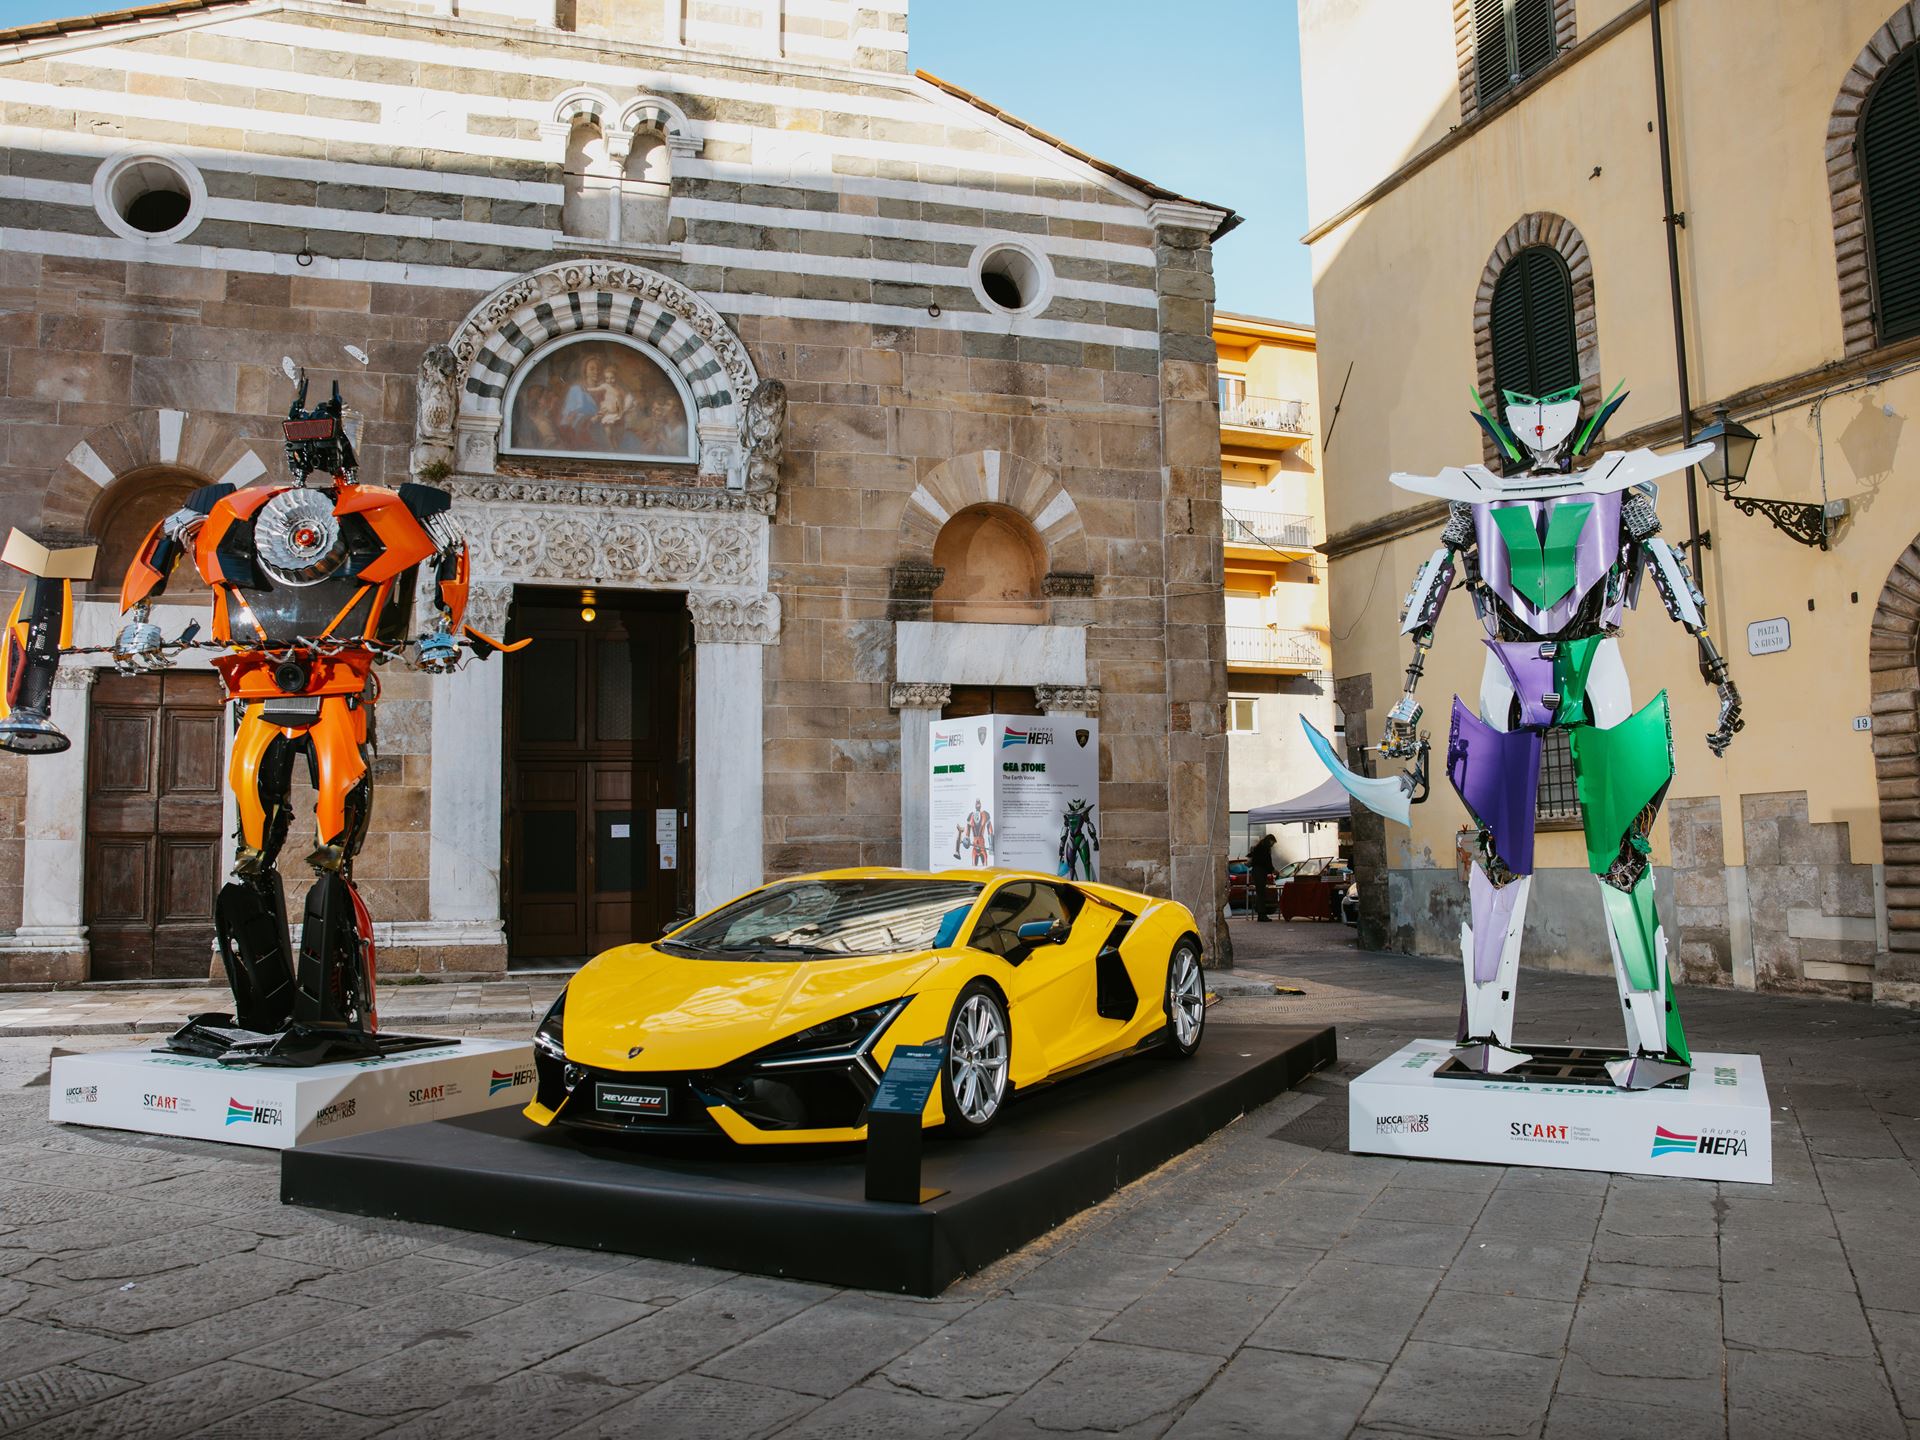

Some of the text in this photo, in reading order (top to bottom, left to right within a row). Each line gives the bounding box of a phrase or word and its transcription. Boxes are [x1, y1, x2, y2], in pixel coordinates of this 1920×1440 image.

[1757, 626, 1779, 636] PIAZZA
[1761, 637, 1783, 647] GIUSTO
[1857, 718, 1867, 728] 19
[1028, 732, 1053, 744] HERA
[1003, 762, 1045, 772] GEA STONE
[513, 1069, 537, 1086] HERA
[409, 1085, 445, 1102] SCART
[1542, 1087, 1617, 1095] STONE
[144, 1094, 178, 1109] SCART
[603, 1093, 661, 1104] REVUELTO
[254, 1106, 282, 1125] HERA
[317, 1105, 337, 1118] LUCCA
[1376, 1116, 1403, 1125] LUCCA
[1419, 1114, 1429, 1123] 25
[1376, 1121, 1429, 1135] FRENCH KISS
[1511, 1122, 1568, 1139] SCART
[1702, 1128, 1747, 1136] GRUPPO
[1698, 1136, 1748, 1157] HERA
